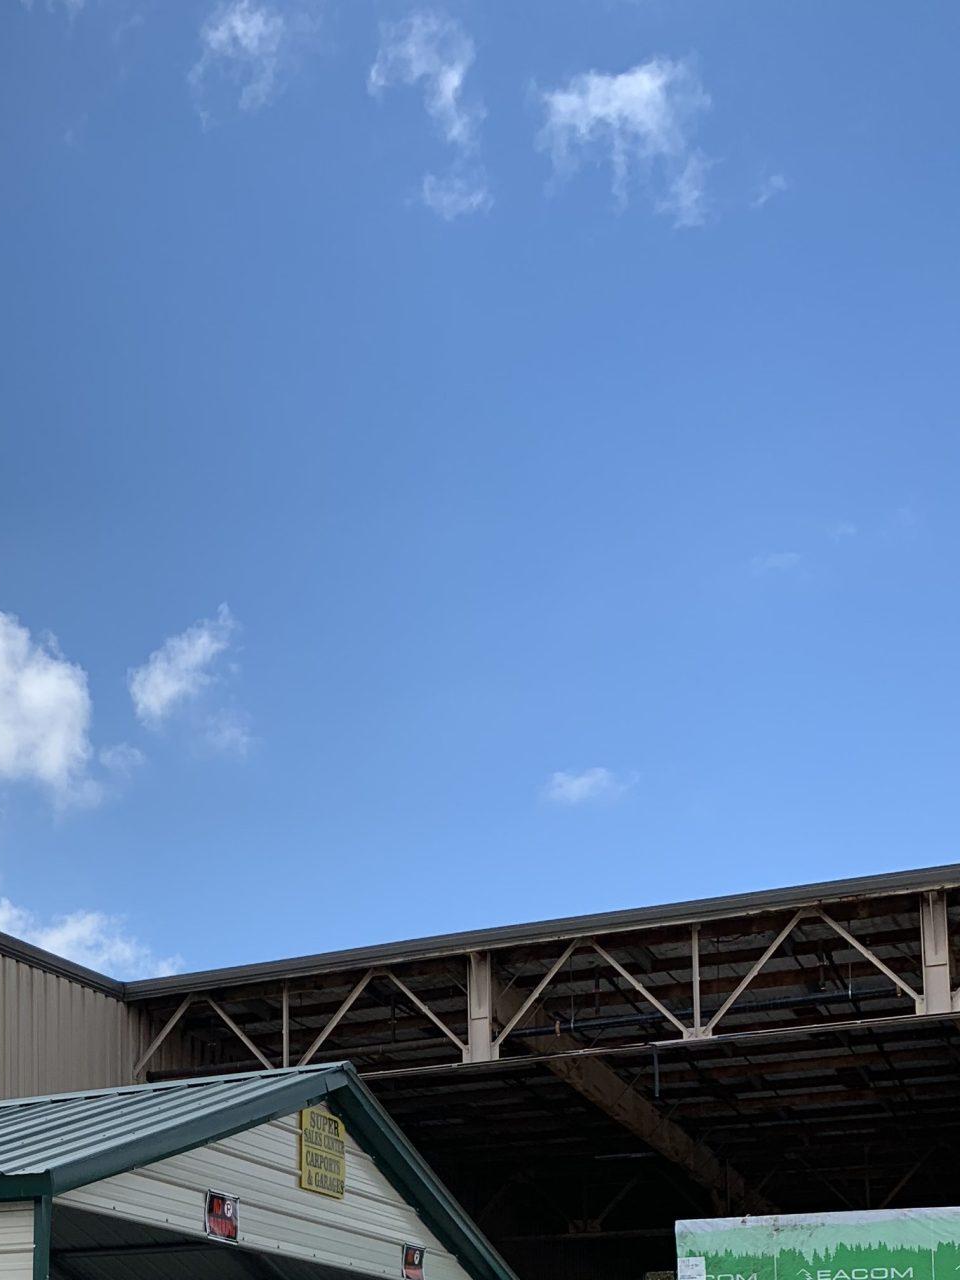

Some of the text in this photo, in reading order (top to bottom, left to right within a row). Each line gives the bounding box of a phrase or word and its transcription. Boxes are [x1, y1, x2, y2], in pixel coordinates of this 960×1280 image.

[310, 1111, 340, 1137] SUPER
[304, 1128, 323, 1147] SALES
[306, 1151, 341, 1175] CARPORTS
[315, 1172, 344, 1195] GARAGES
[817, 1267, 913, 1280] EACOM
